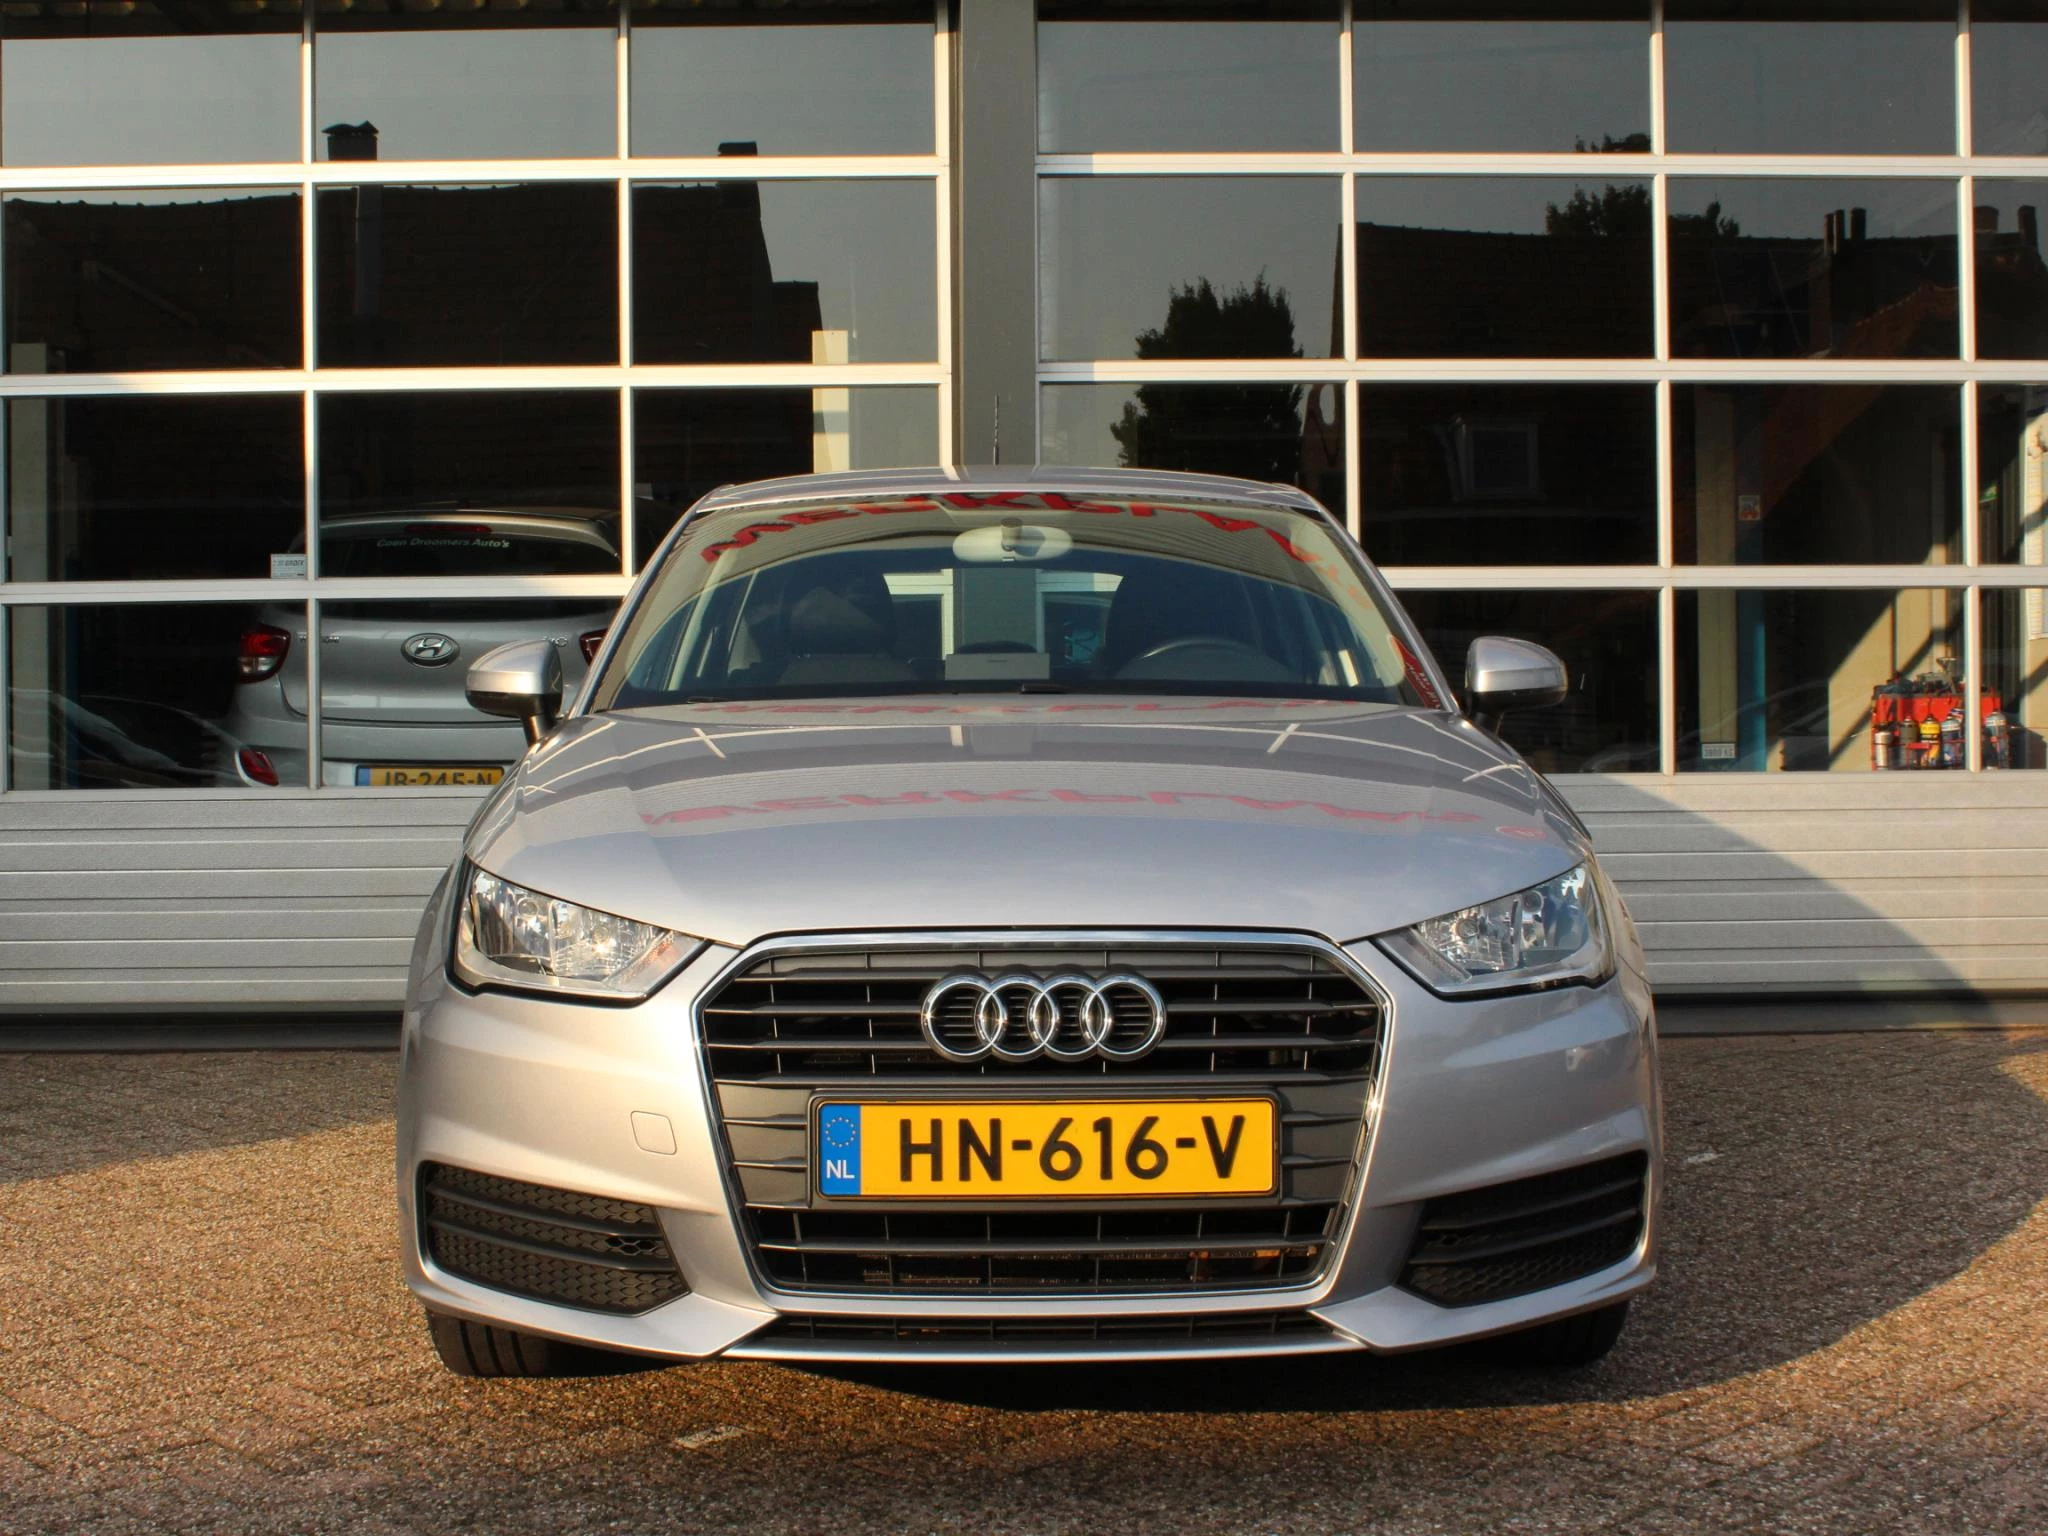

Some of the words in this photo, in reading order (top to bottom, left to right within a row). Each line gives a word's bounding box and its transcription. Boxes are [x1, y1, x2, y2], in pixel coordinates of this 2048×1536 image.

[471, 538, 511, 549] Auto's
[826, 1159, 855, 1180] NL
[899, 1115, 1246, 1183] HN-616-V
